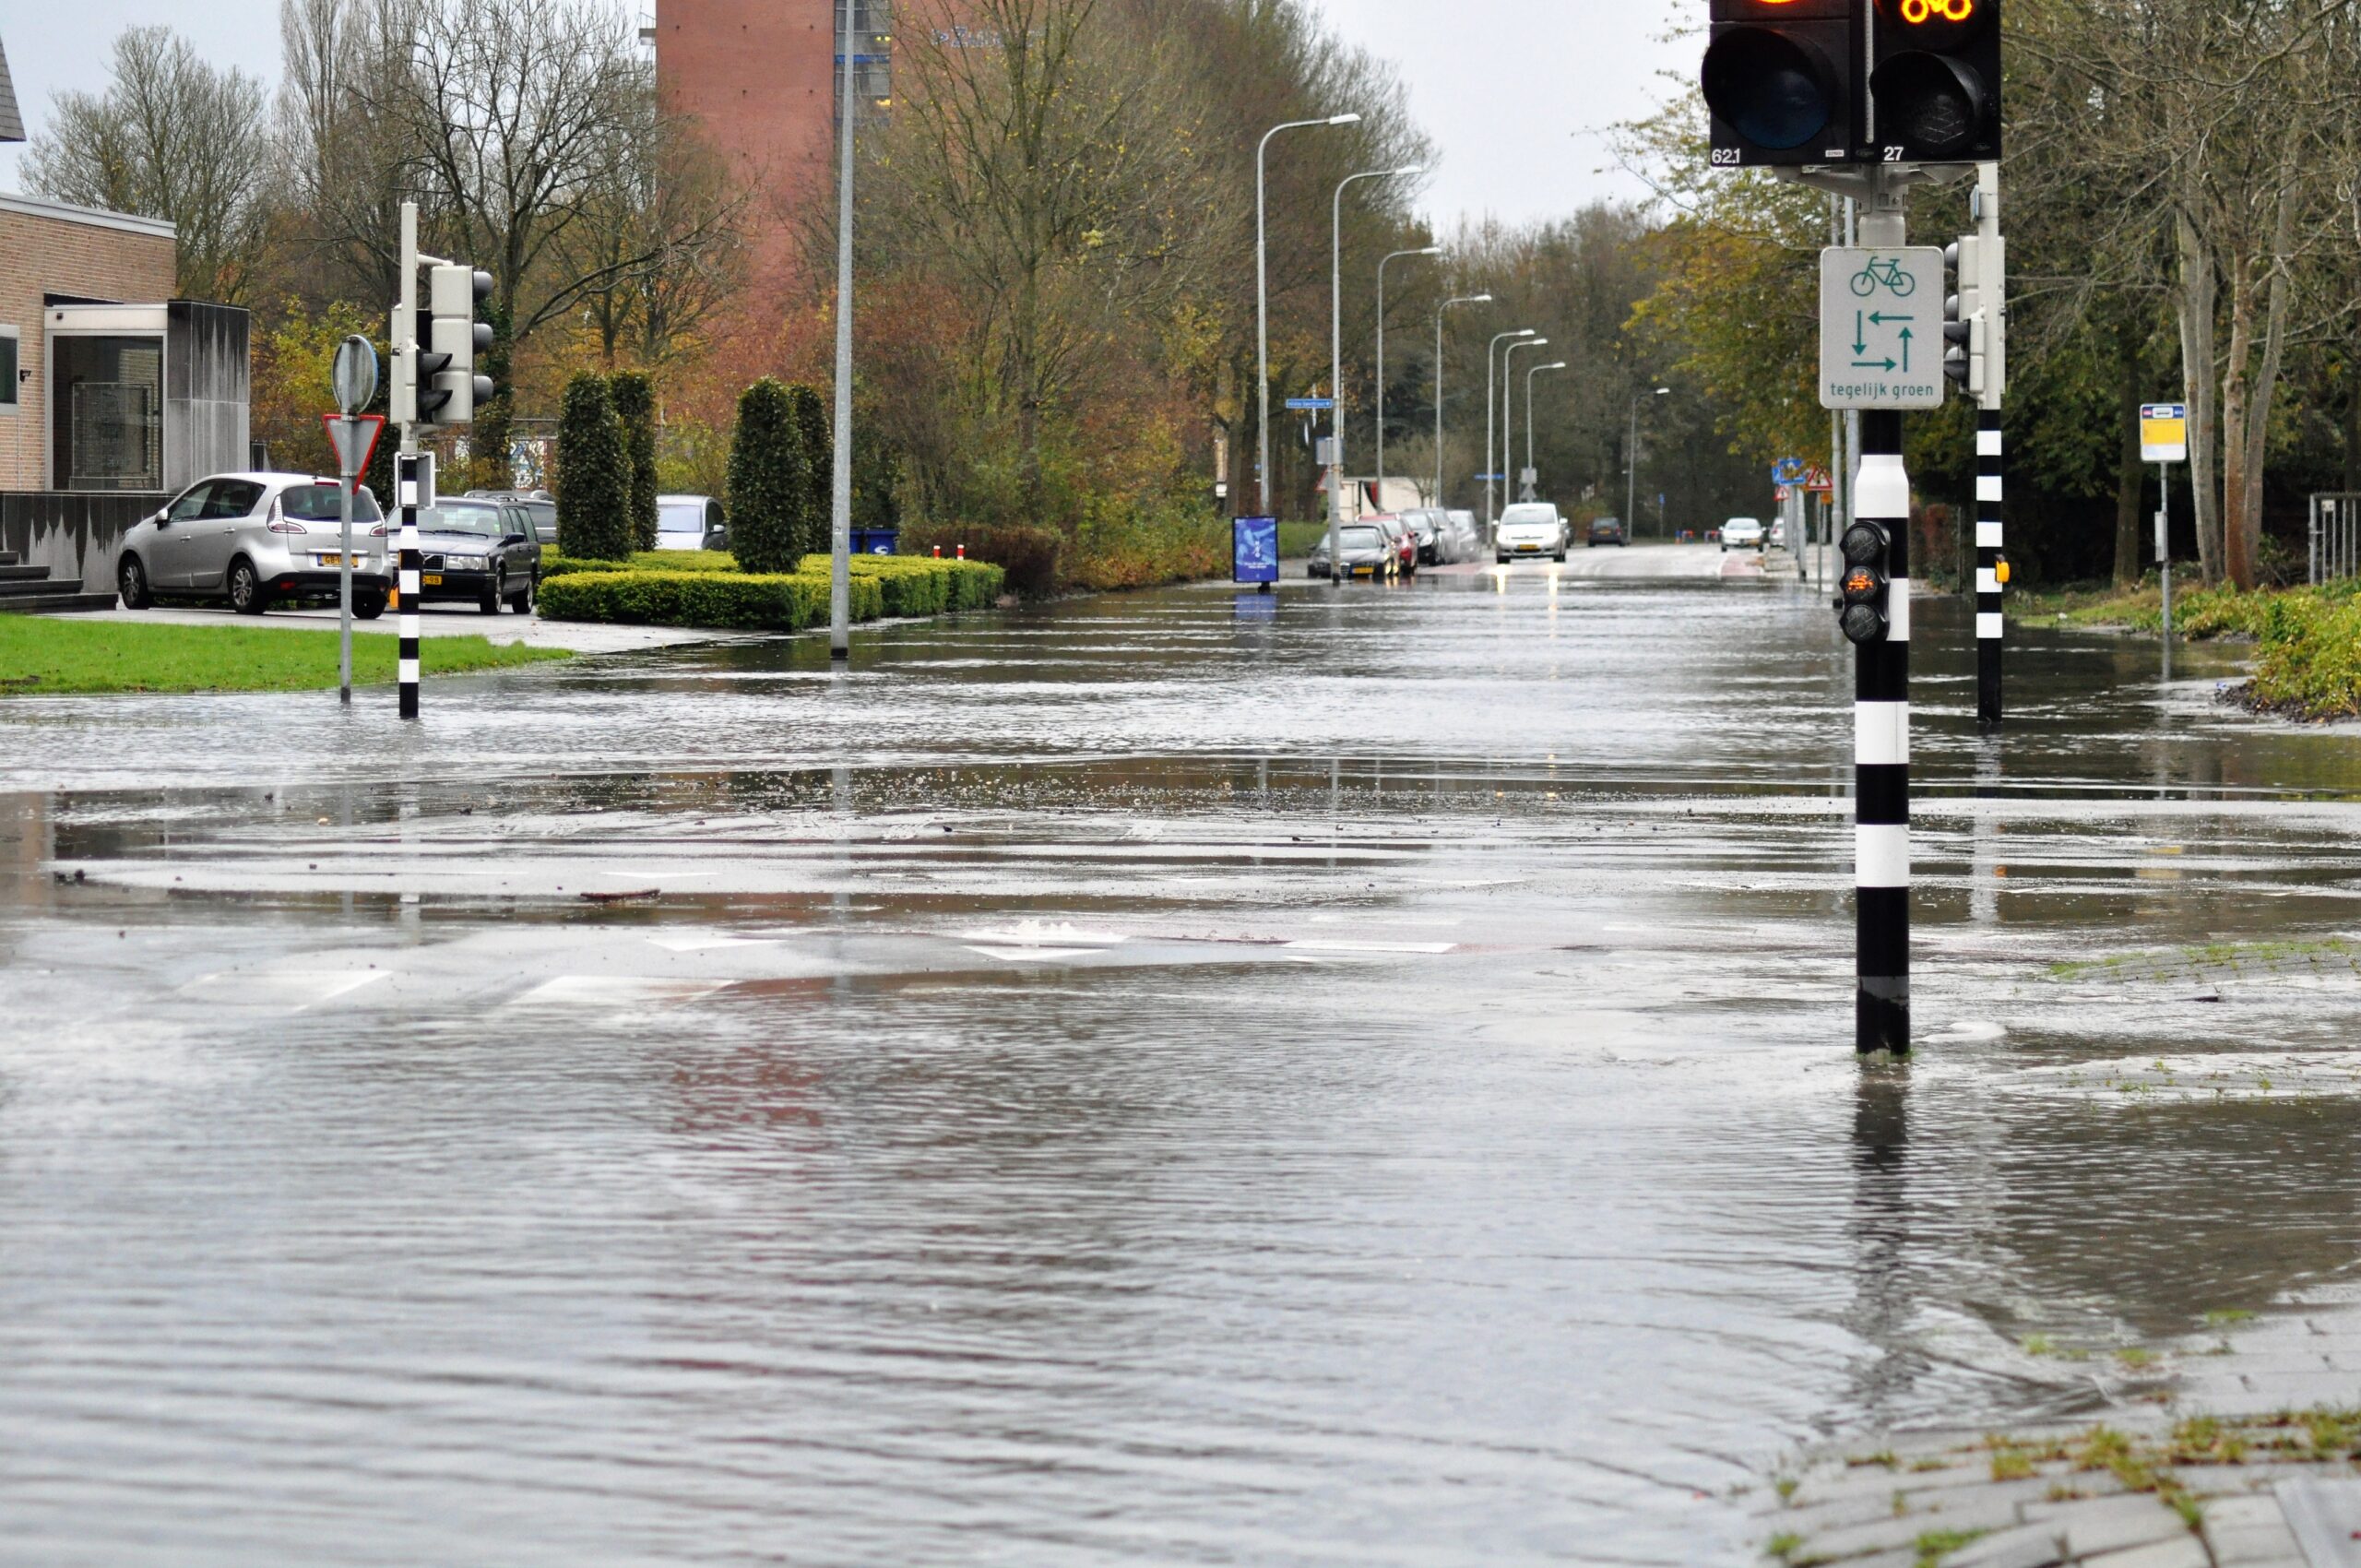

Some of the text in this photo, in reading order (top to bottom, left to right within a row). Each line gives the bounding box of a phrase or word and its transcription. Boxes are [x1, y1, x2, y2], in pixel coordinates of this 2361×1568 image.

[1883, 146, 1904, 161] 27
[1831, 383, 1933, 400] tegelijk groen
